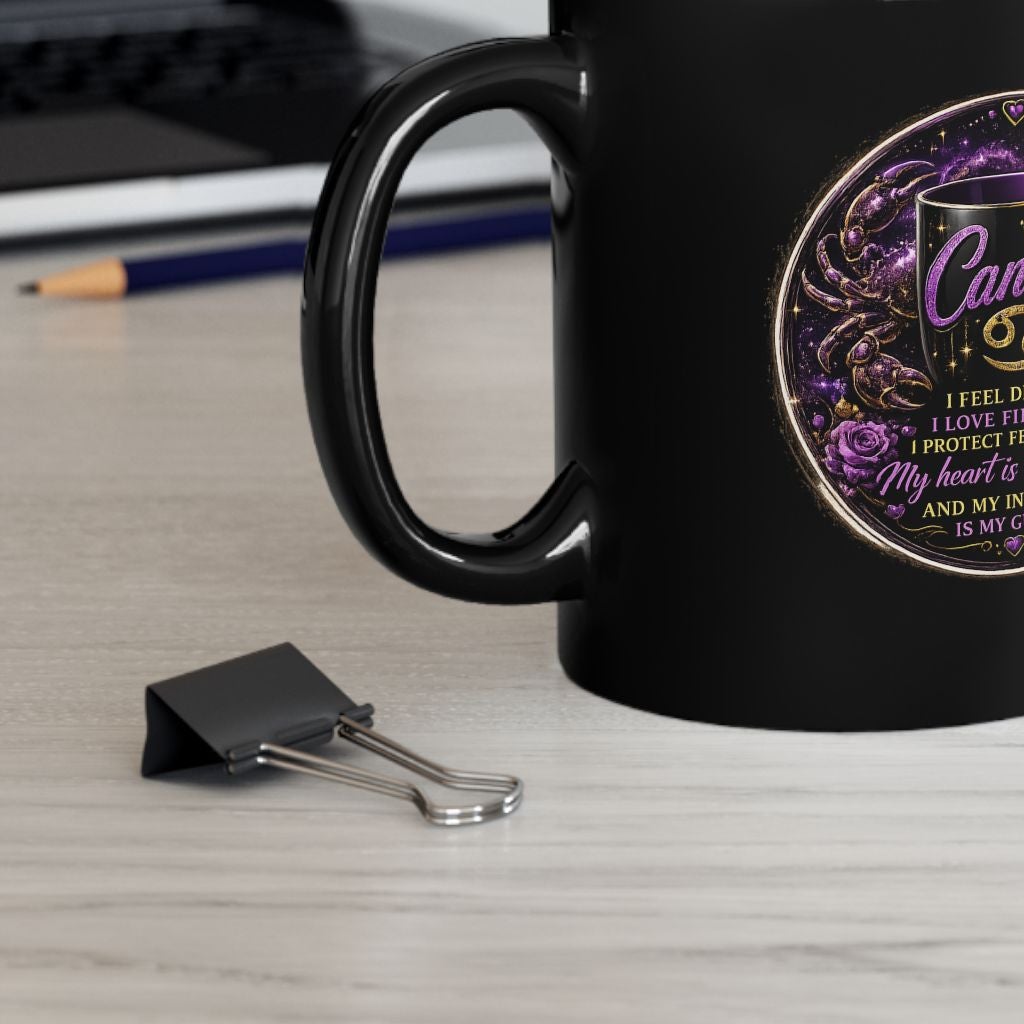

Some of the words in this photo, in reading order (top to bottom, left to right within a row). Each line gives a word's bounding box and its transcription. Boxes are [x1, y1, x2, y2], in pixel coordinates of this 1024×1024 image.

[946, 393, 952, 409] I
[959, 388, 1004, 408] FEEL
[931, 416, 938, 433] I
[945, 412, 995, 432] LOVE
[911, 440, 917, 455] I
[923, 432, 1004, 455] PROTECT
[876, 461, 931, 505] My
[935, 452, 1005, 487] heart
[1002, 456, 1018, 482] is
[922, 500, 965, 519] AND
[972, 495, 1001, 514] MY
[956, 521, 974, 537] IS
[979, 516, 1006, 535] MY
